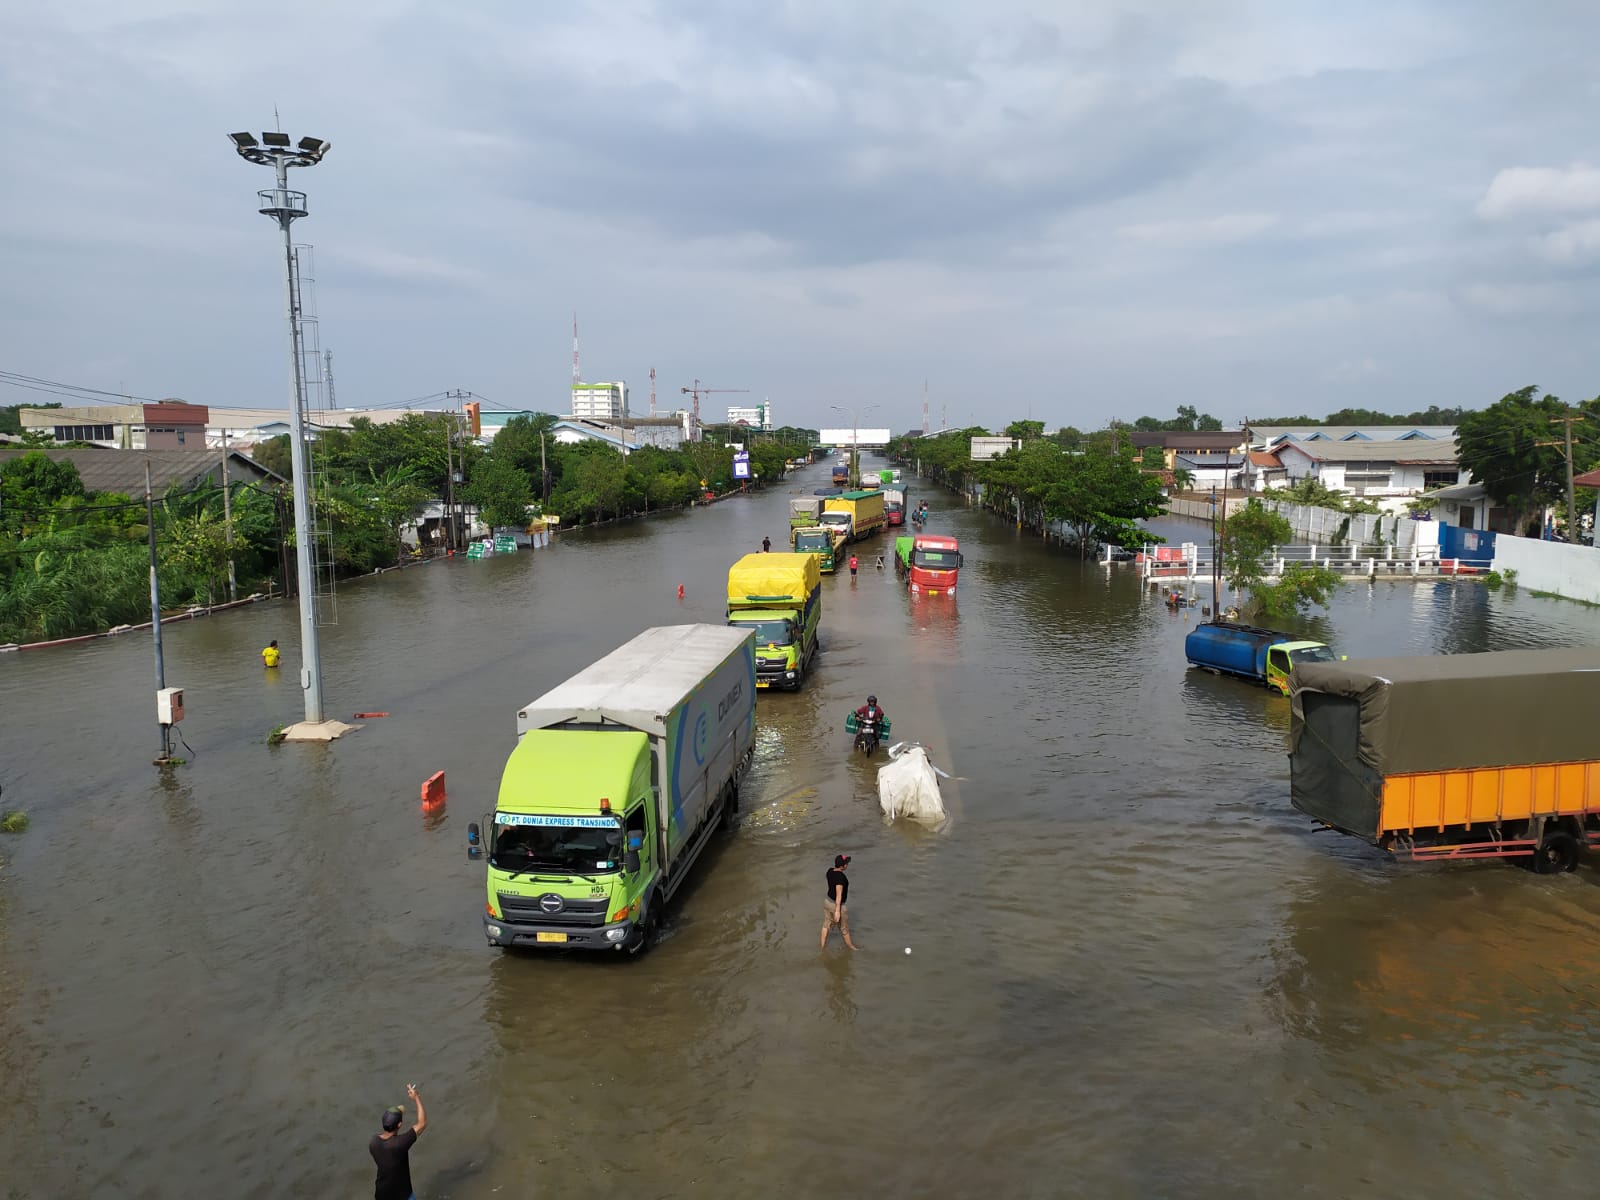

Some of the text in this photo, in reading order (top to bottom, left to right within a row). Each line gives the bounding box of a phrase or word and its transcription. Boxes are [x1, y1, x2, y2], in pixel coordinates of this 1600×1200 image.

[511, 816, 616, 827] PT. DUNIA EXPRESS TRANSINDO
